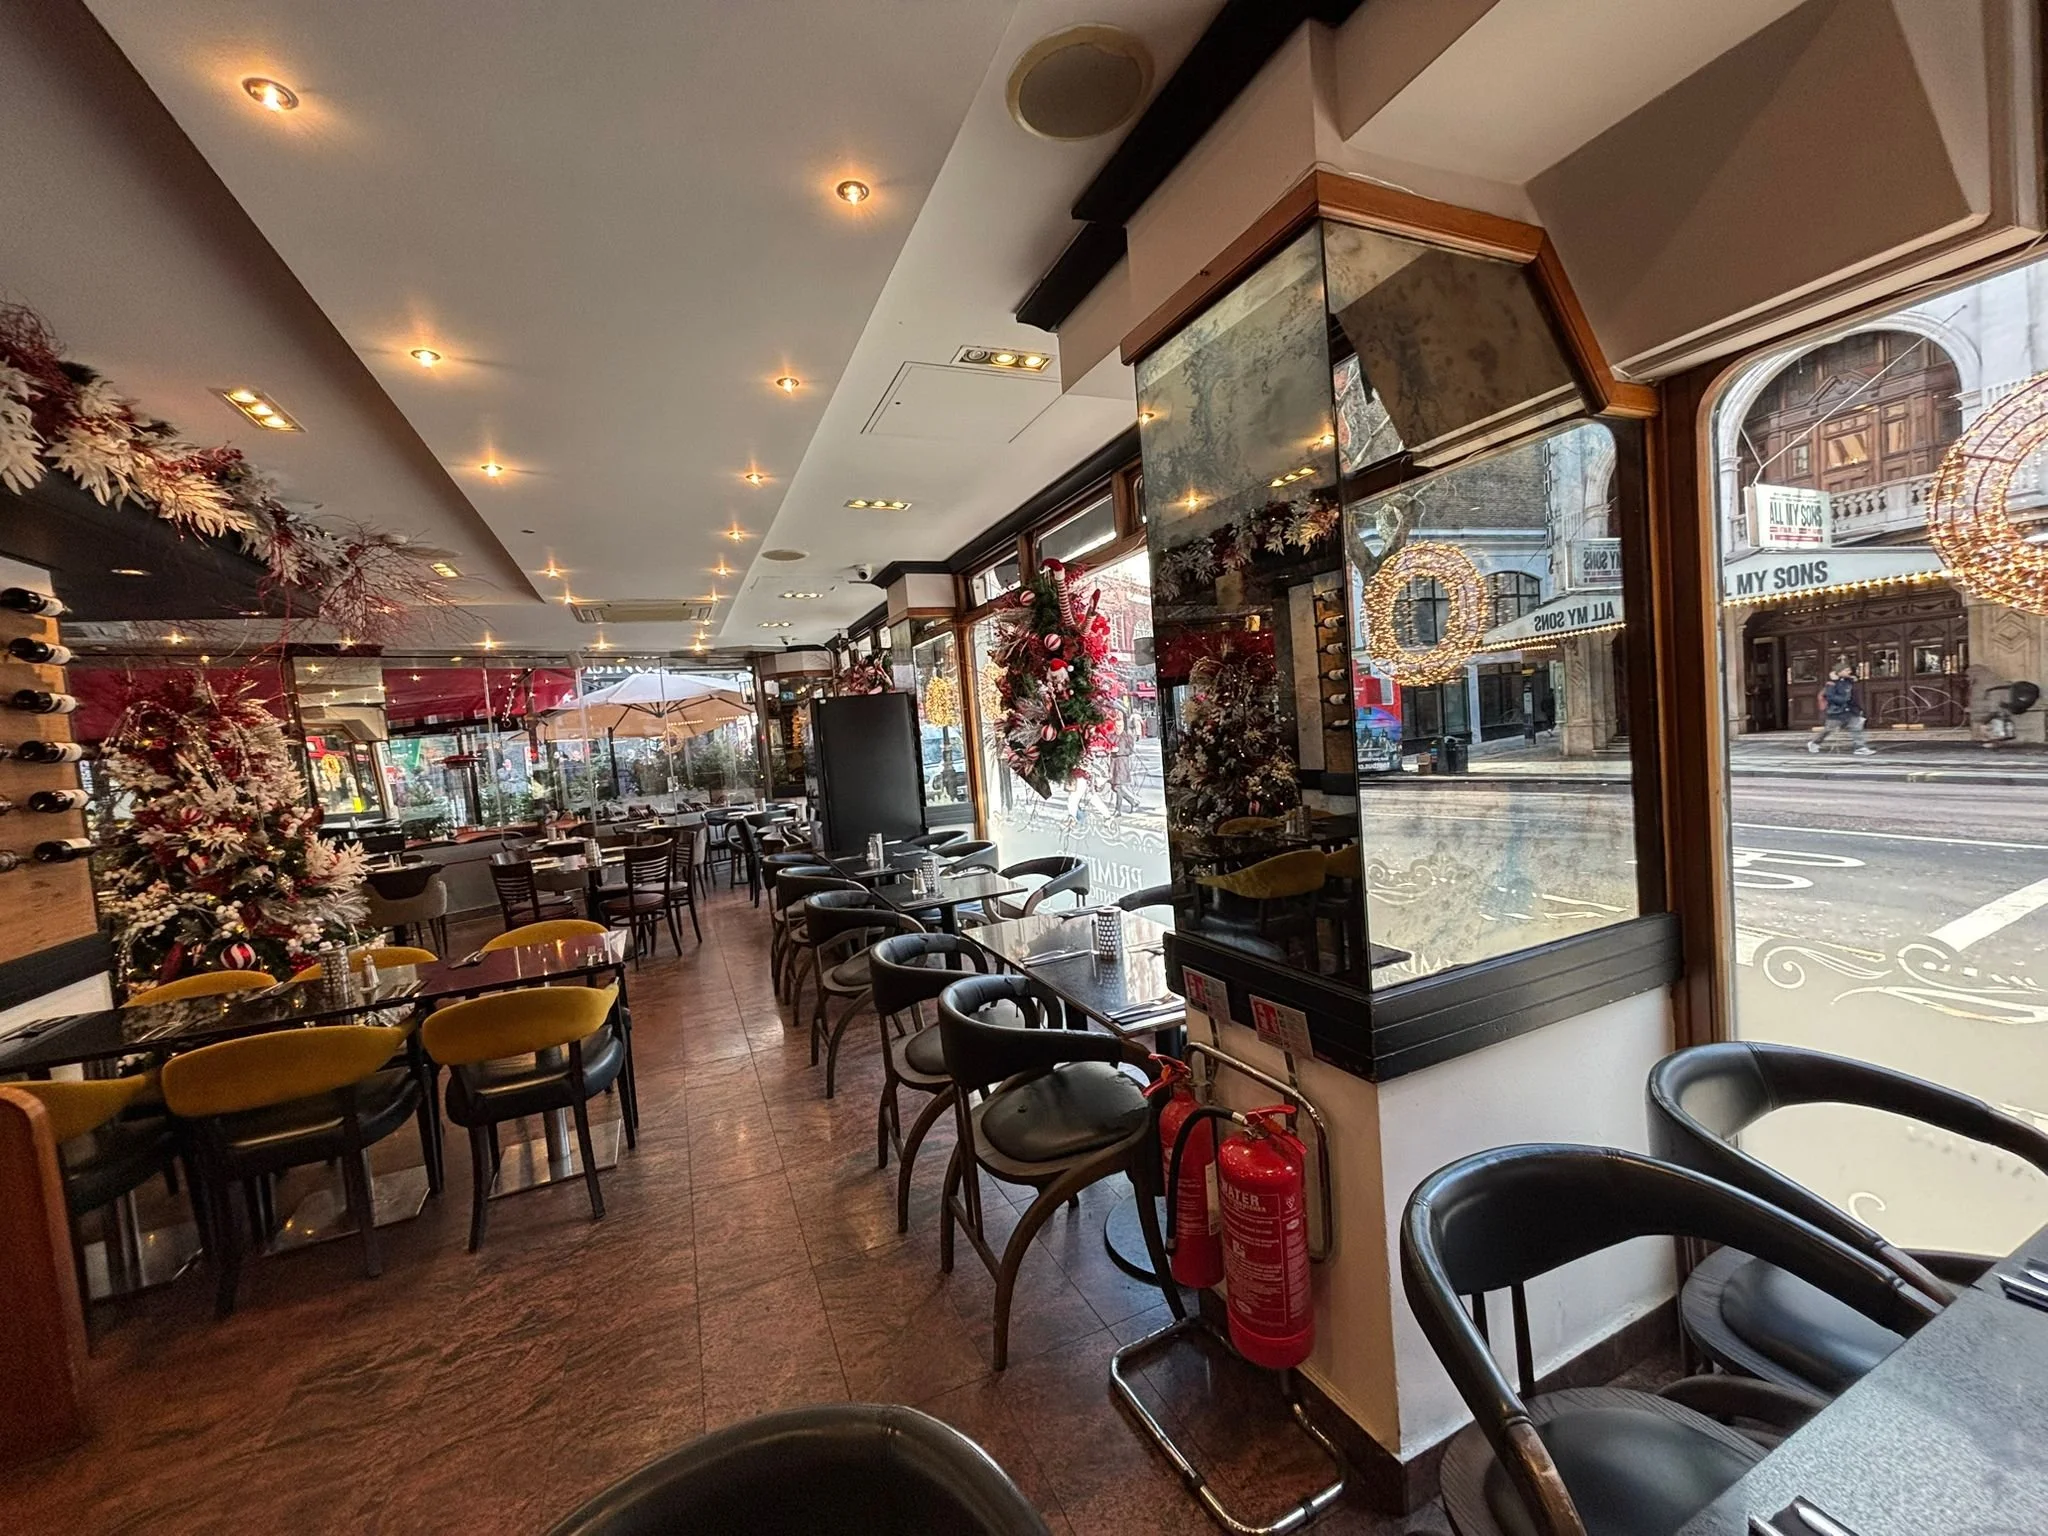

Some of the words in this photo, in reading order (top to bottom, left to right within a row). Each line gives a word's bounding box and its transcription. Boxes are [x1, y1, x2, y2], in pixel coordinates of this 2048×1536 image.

[1770, 502, 1784, 525] ALL
[1786, 503, 1799, 526] MY
[1801, 504, 1823, 527] SONS
[1736, 570, 1768, 595] MY
[1773, 560, 1828, 589] SONS
[1220, 1181, 1260, 1207] WATER
